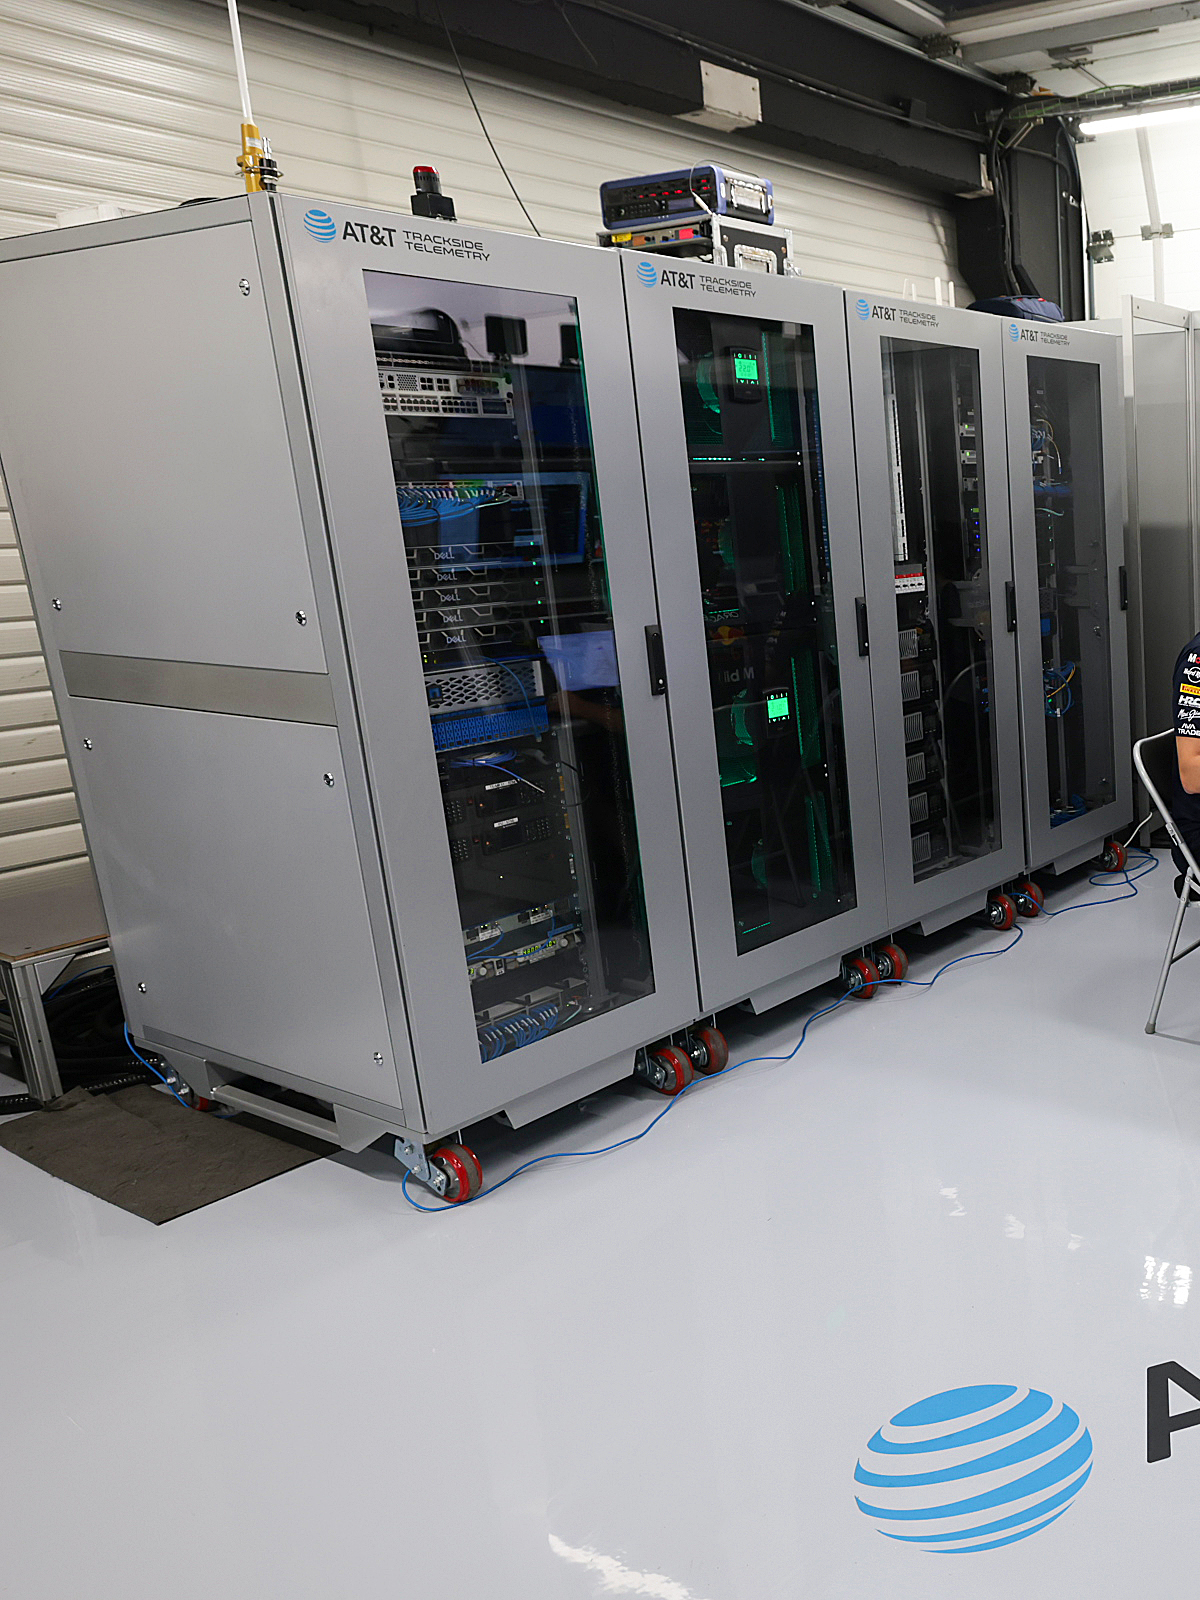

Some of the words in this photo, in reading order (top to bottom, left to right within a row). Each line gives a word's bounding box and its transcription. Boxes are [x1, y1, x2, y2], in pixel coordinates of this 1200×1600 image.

[342, 221, 397, 248] AT&T
[403, 230, 484, 251] TRACKSIDE
[404, 240, 491, 262] TELEMETRY
[660, 270, 696, 290] AT&T
[699, 275, 752, 289] TRACKSIDE
[700, 284, 757, 298] TELEMETRY
[871, 305, 896, 322] AT&T
[899, 309, 937, 321] TRACKSIDE
[900, 316, 940, 328] TELEMETRY
[1020, 329, 1039, 342] AT&T
[1040, 337, 1071, 347] TELEMETRY
